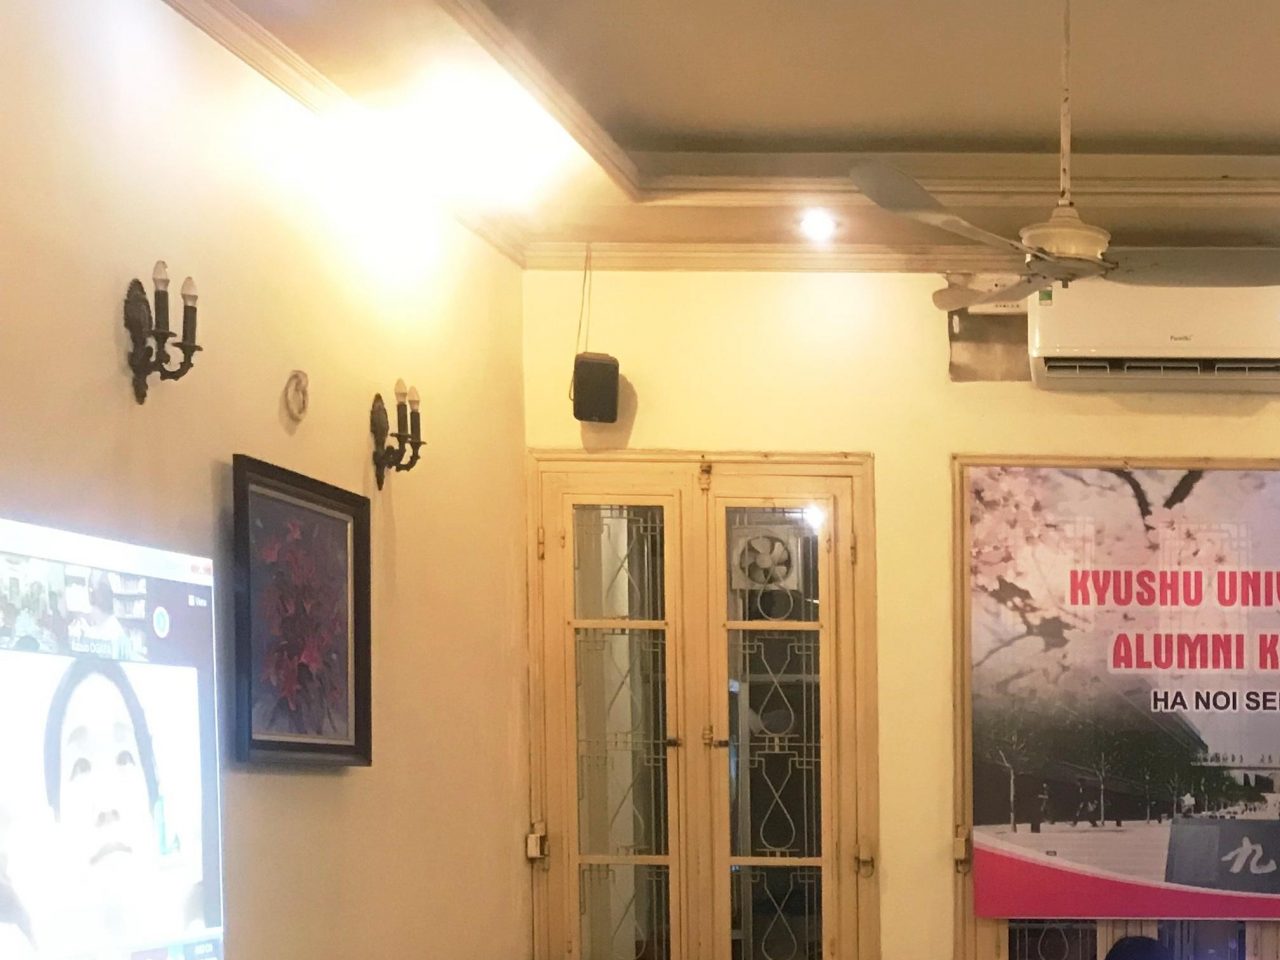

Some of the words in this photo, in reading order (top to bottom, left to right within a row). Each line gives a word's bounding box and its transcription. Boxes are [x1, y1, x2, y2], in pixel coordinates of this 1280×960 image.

[1069, 569, 1204, 607] KYUSHU
[1112, 633, 1245, 670] ALUMNI
[1152, 690, 1188, 711] HA
[1194, 690, 1237, 711] NOI
